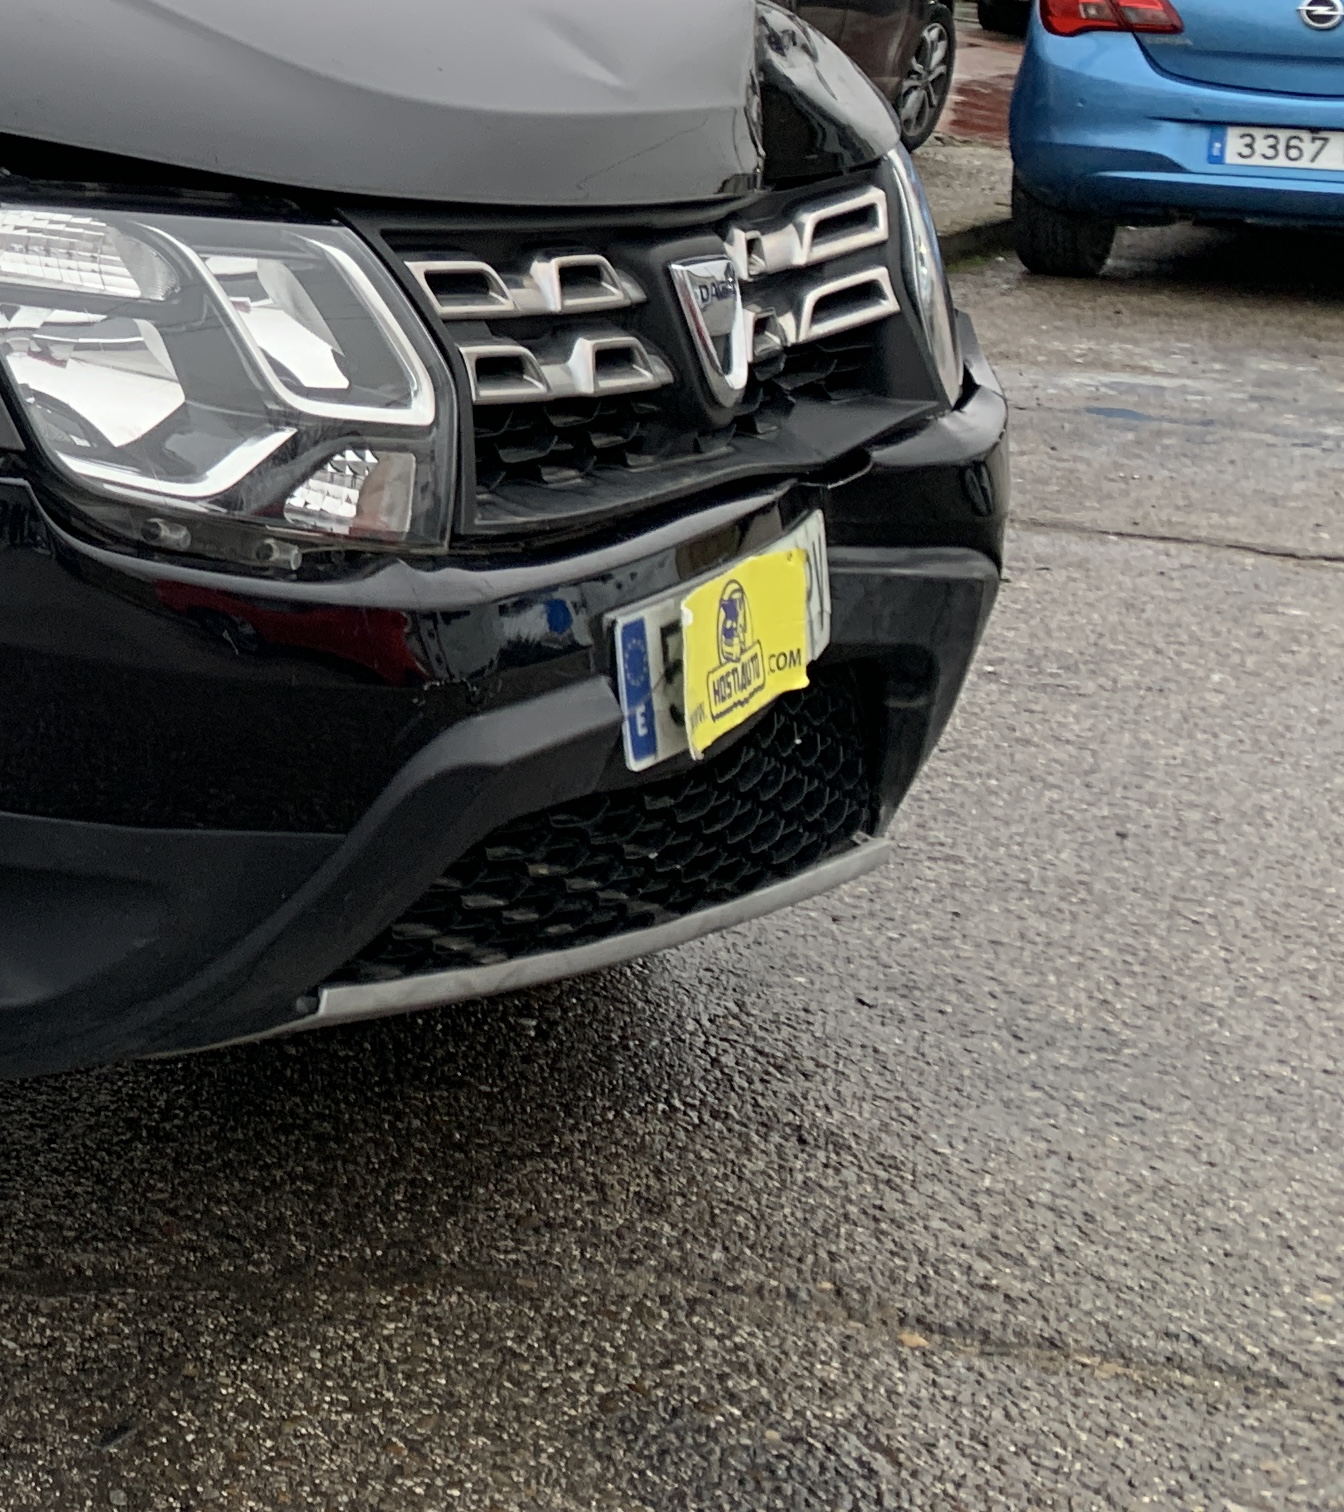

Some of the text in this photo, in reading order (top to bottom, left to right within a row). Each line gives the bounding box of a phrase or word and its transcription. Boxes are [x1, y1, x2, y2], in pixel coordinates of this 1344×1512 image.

[1237, 133, 1330, 163] 3367
[713, 653, 760, 706] HOSTIAUTO
[636, 703, 648, 737] E
